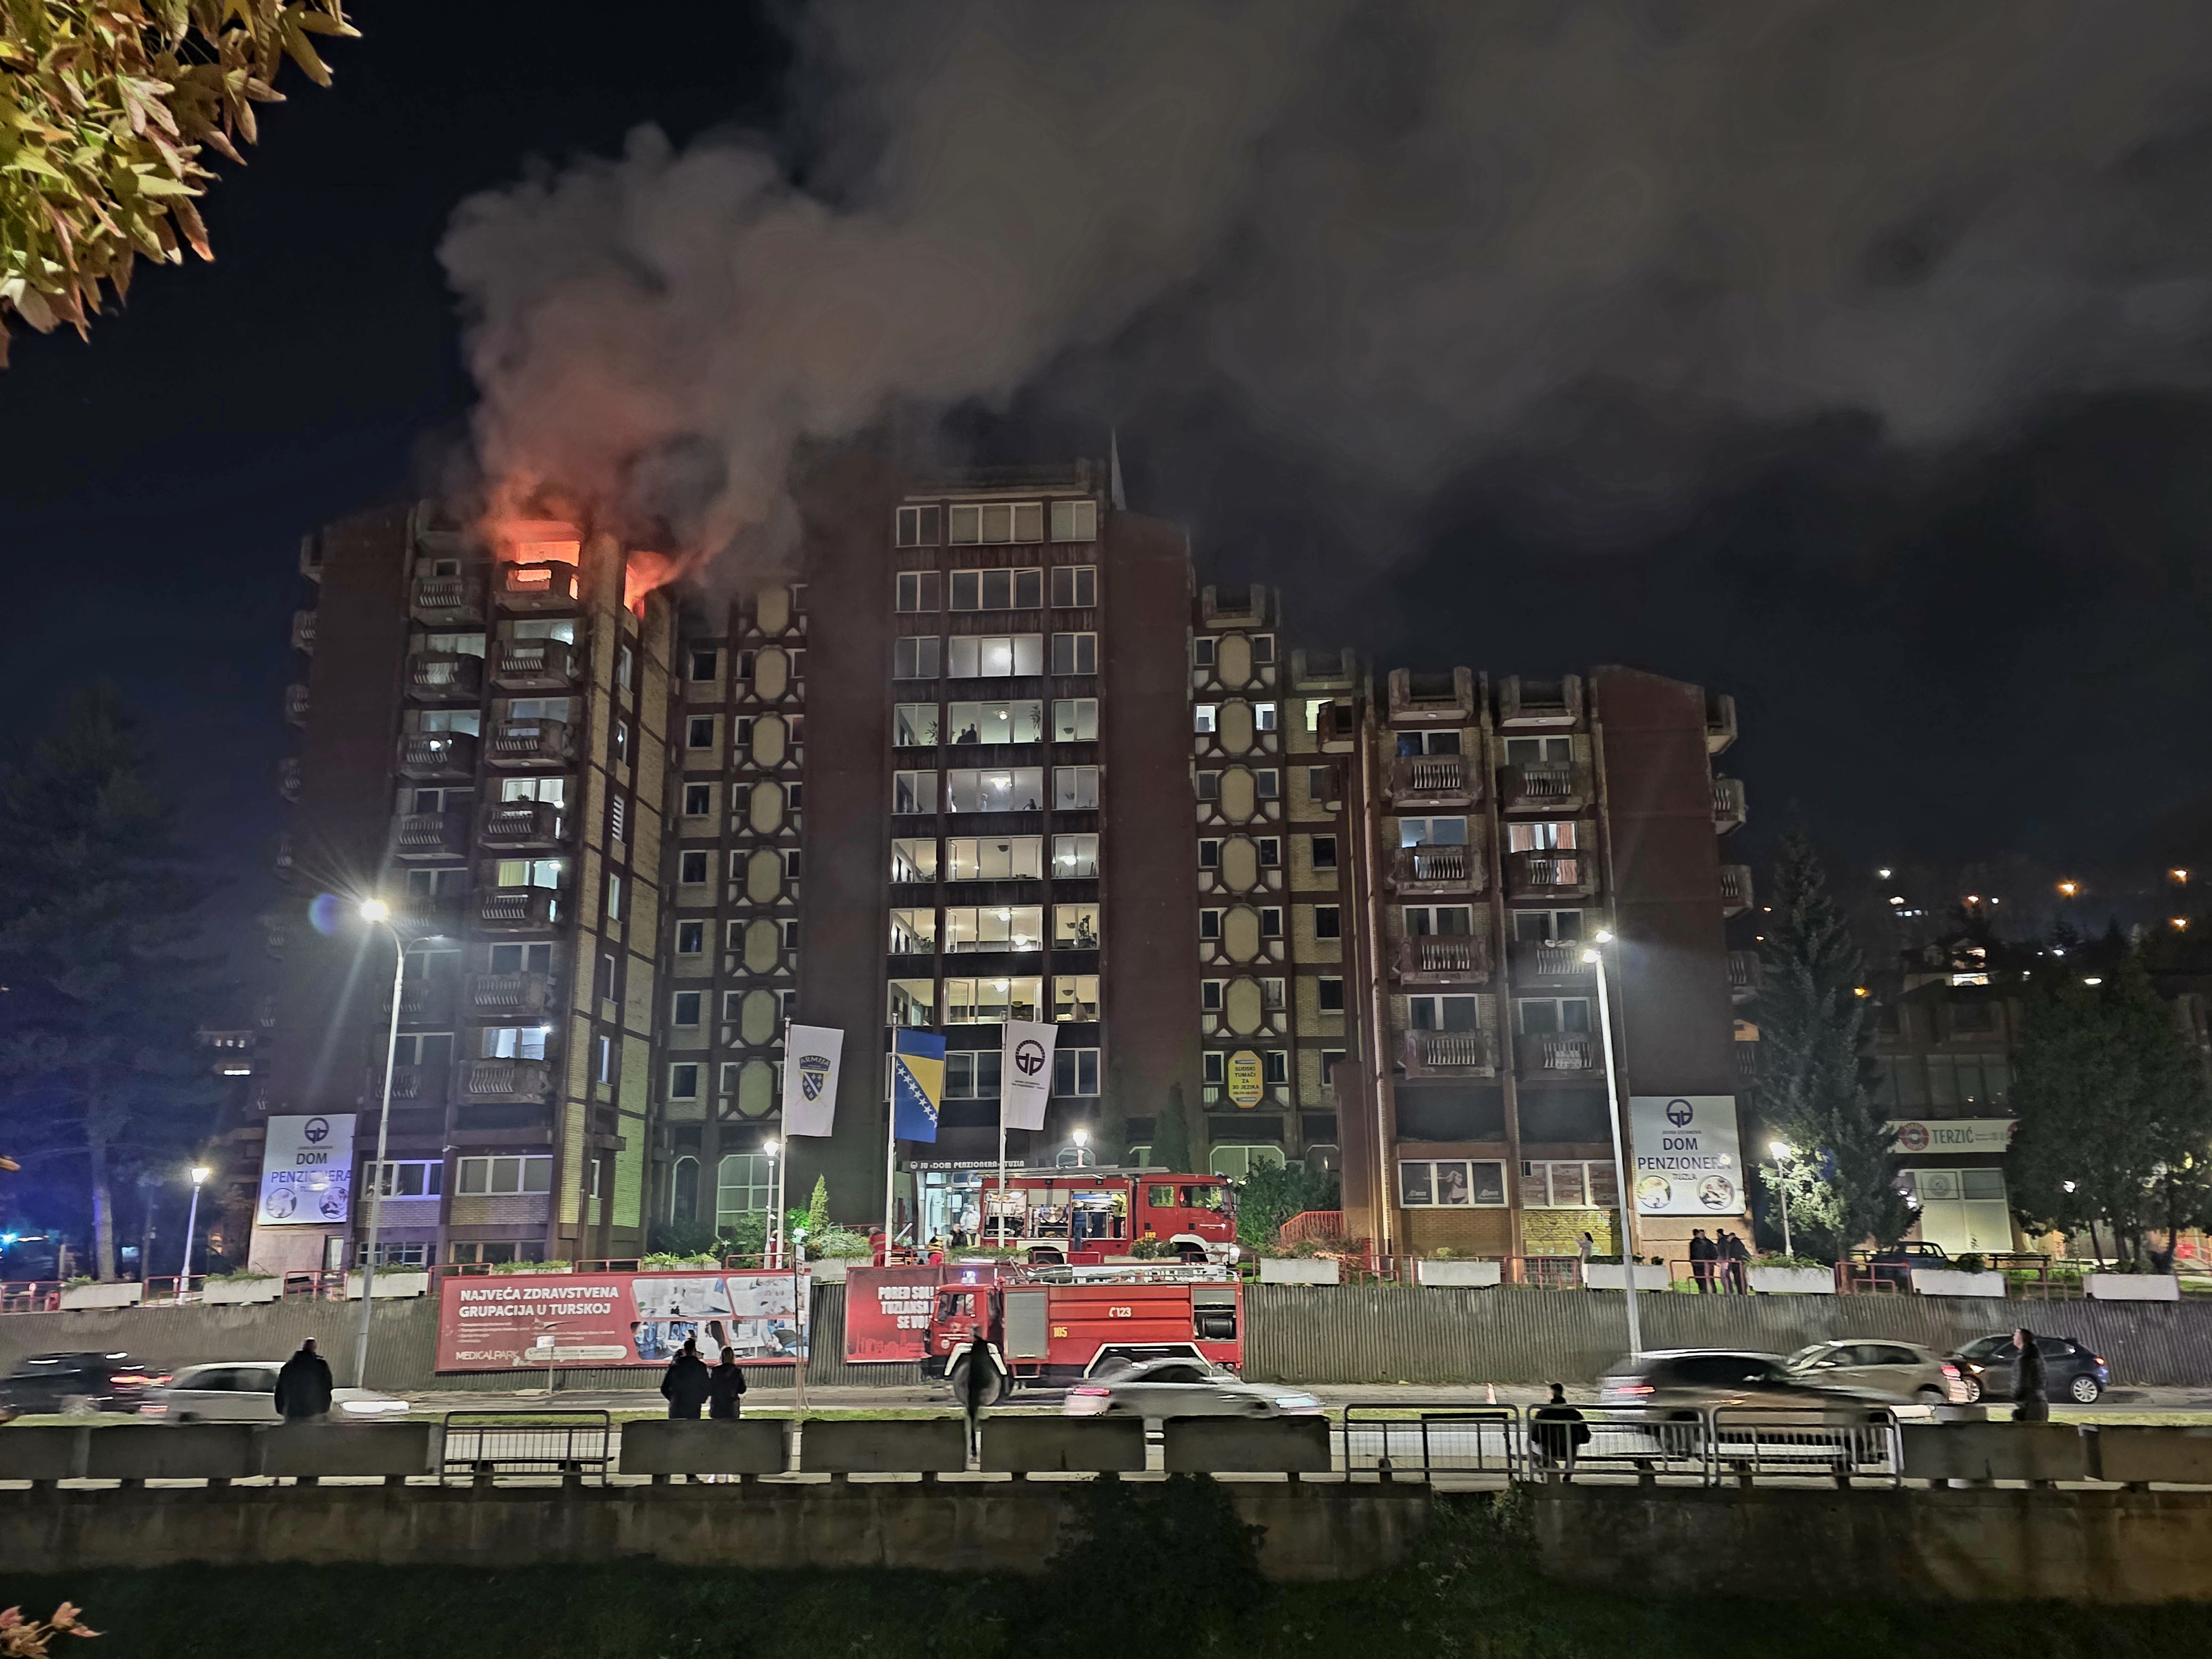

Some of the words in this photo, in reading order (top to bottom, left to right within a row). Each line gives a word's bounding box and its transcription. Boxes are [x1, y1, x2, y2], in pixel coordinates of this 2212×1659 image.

[800, 1056, 830, 1066] ARMIJA
[1932, 1126, 1974, 1144] TERZIĆ
[1663, 1138, 1698, 1150] DOM
[296, 1152, 327, 1165] DOM
[271, 1170, 352, 1183] PENZIERA
[460, 1287, 521, 1301] NAJVEĆA
[523, 1287, 619, 1300] ZDRAVSTVENA
[878, 1286, 910, 1300] PORED
[459, 1305, 534, 1317] GRUPACIJA
[537, 1304, 546, 1316] U
[549, 1303, 611, 1315] TURSKOJ
[1115, 1307, 1131, 1317] 123
[897, 1316, 910, 1329] SE
[1053, 1327, 1068, 1338] 105
